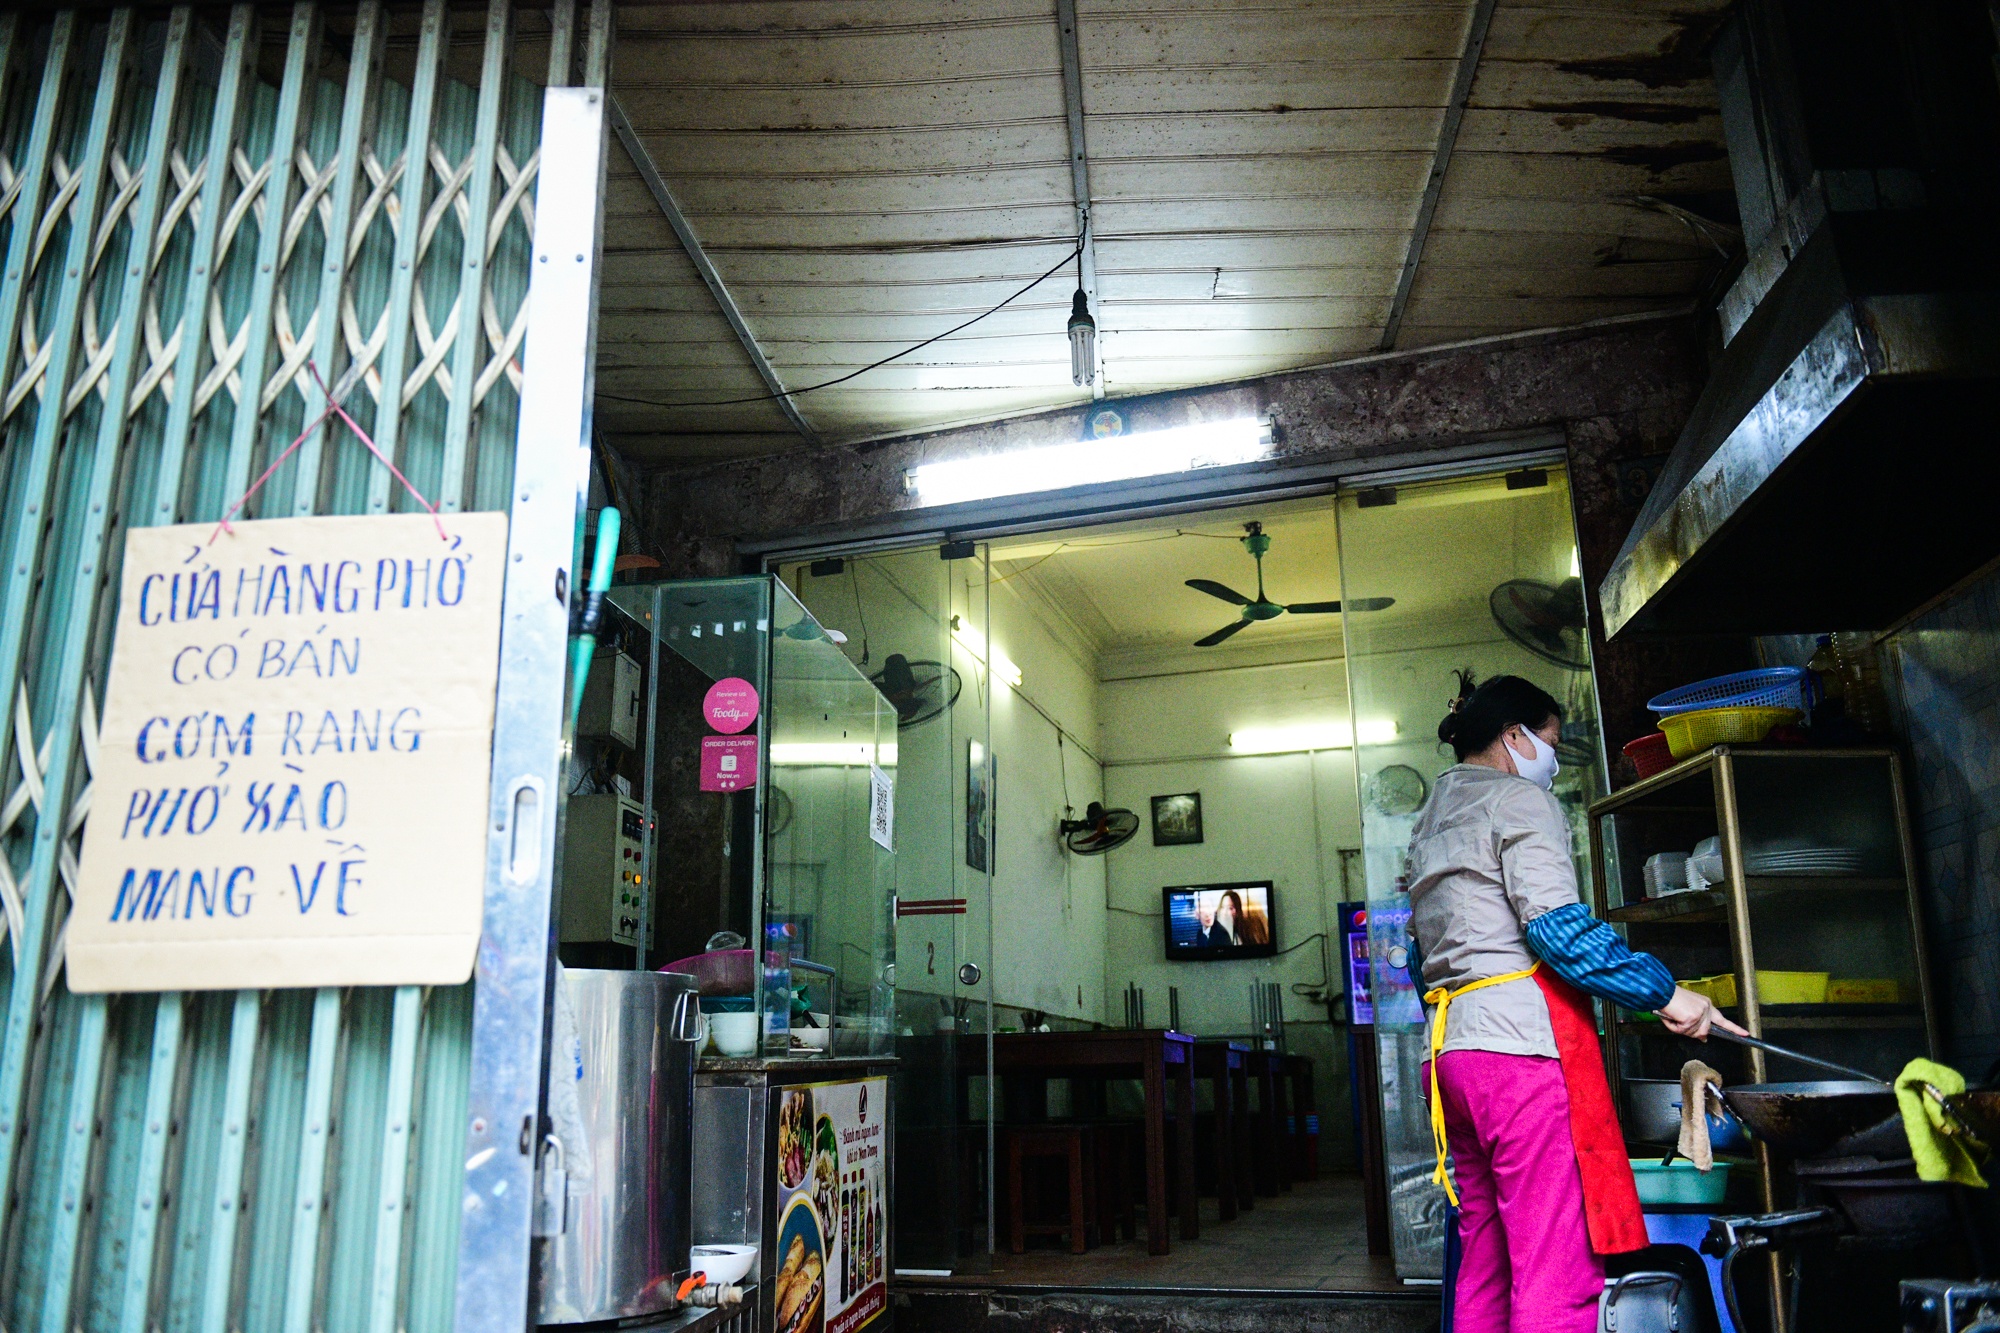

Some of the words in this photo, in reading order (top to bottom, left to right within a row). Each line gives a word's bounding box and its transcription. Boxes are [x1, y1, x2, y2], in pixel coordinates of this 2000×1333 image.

[139, 545, 222, 627] CỬA
[233, 547, 367, 617] HÀNG
[374, 535, 473, 611] PHỞ
[172, 628, 250, 685] CÓ
[257, 624, 361, 680] BÁN
[137, 710, 256, 764] CƠM
[281, 706, 425, 758] RANG
[121, 761, 231, 840] PHỞ
[241, 763, 348, 833] XÀO
[109, 866, 257, 923] MANG
[290, 840, 367, 917] VỀ
